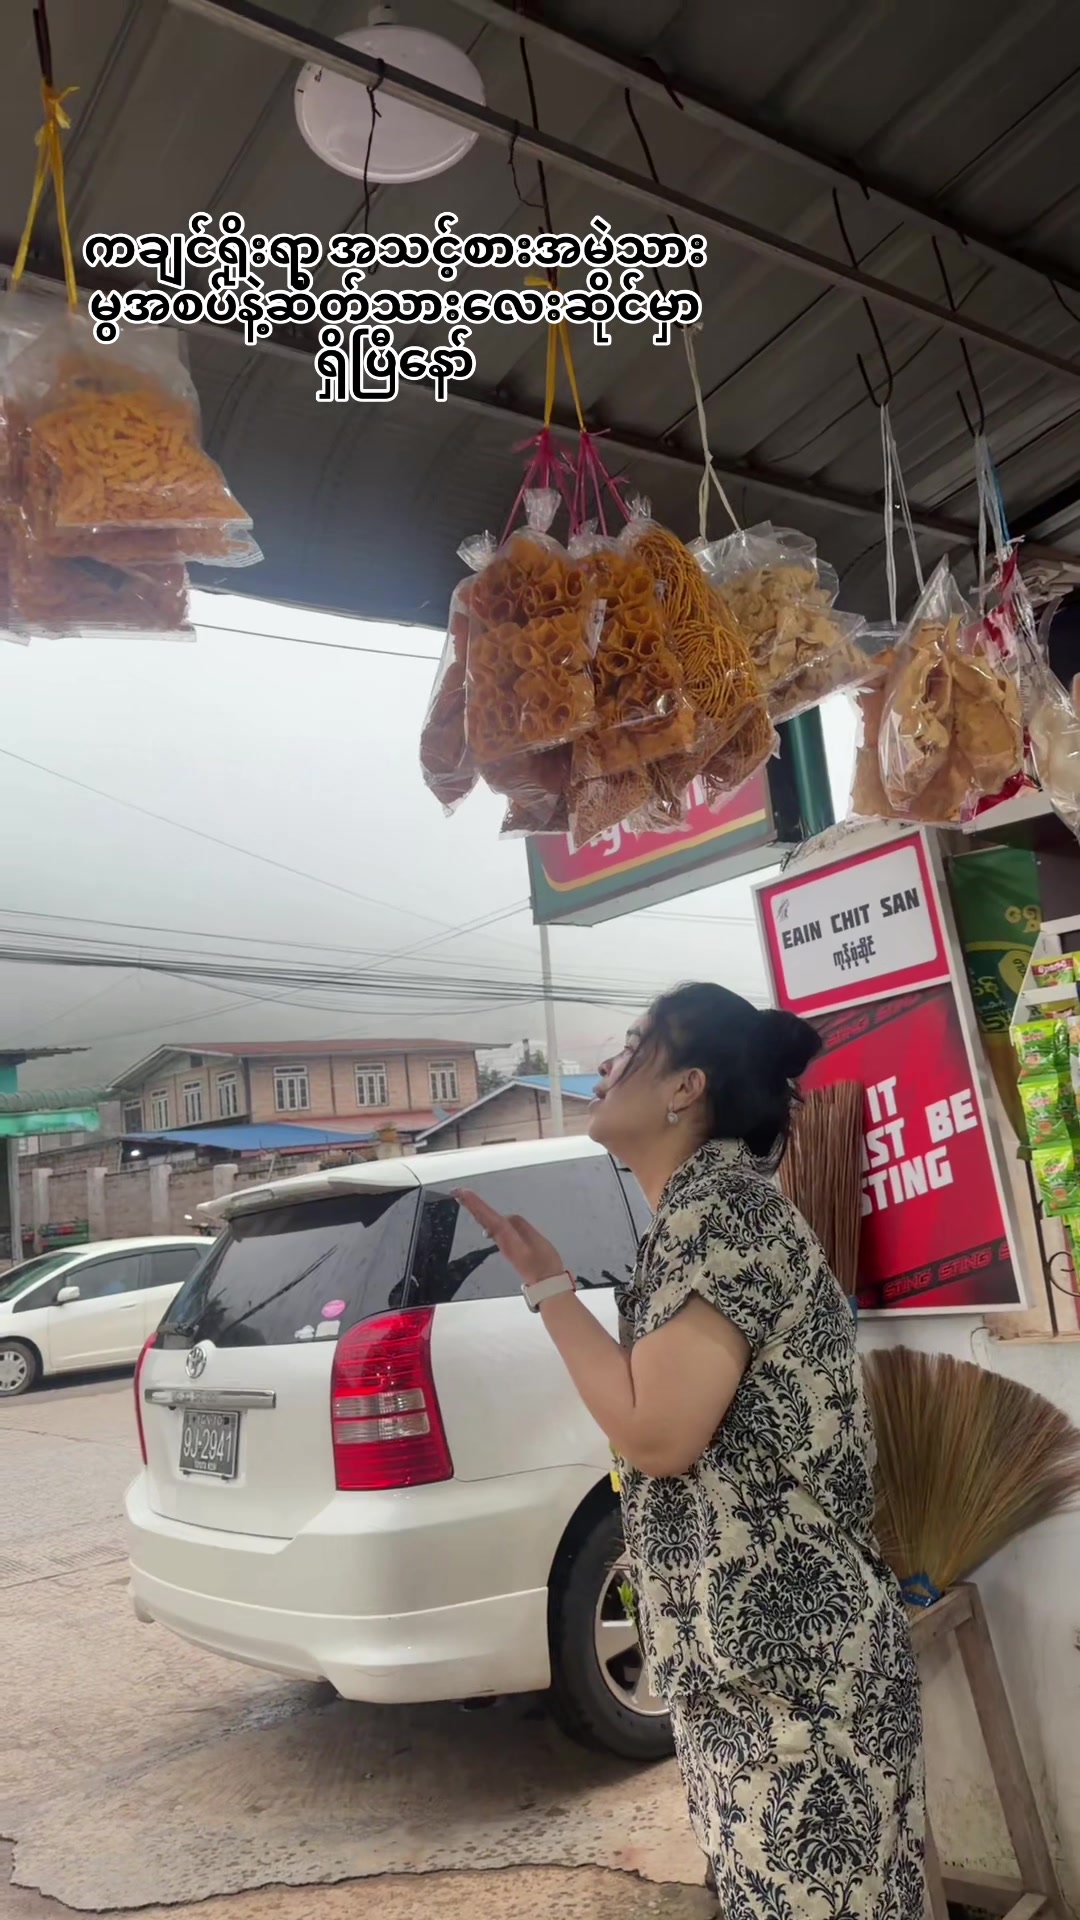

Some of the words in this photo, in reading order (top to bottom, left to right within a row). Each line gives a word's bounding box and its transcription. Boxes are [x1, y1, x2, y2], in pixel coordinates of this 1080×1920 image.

[781, 920, 823, 949] EAIN
[830, 903, 870, 934] CHIT
[879, 887, 920, 918] SAN
[866, 1075, 898, 1124] IT
[924, 1088, 978, 1144] BE
[938, 1250, 992, 1280] STING
